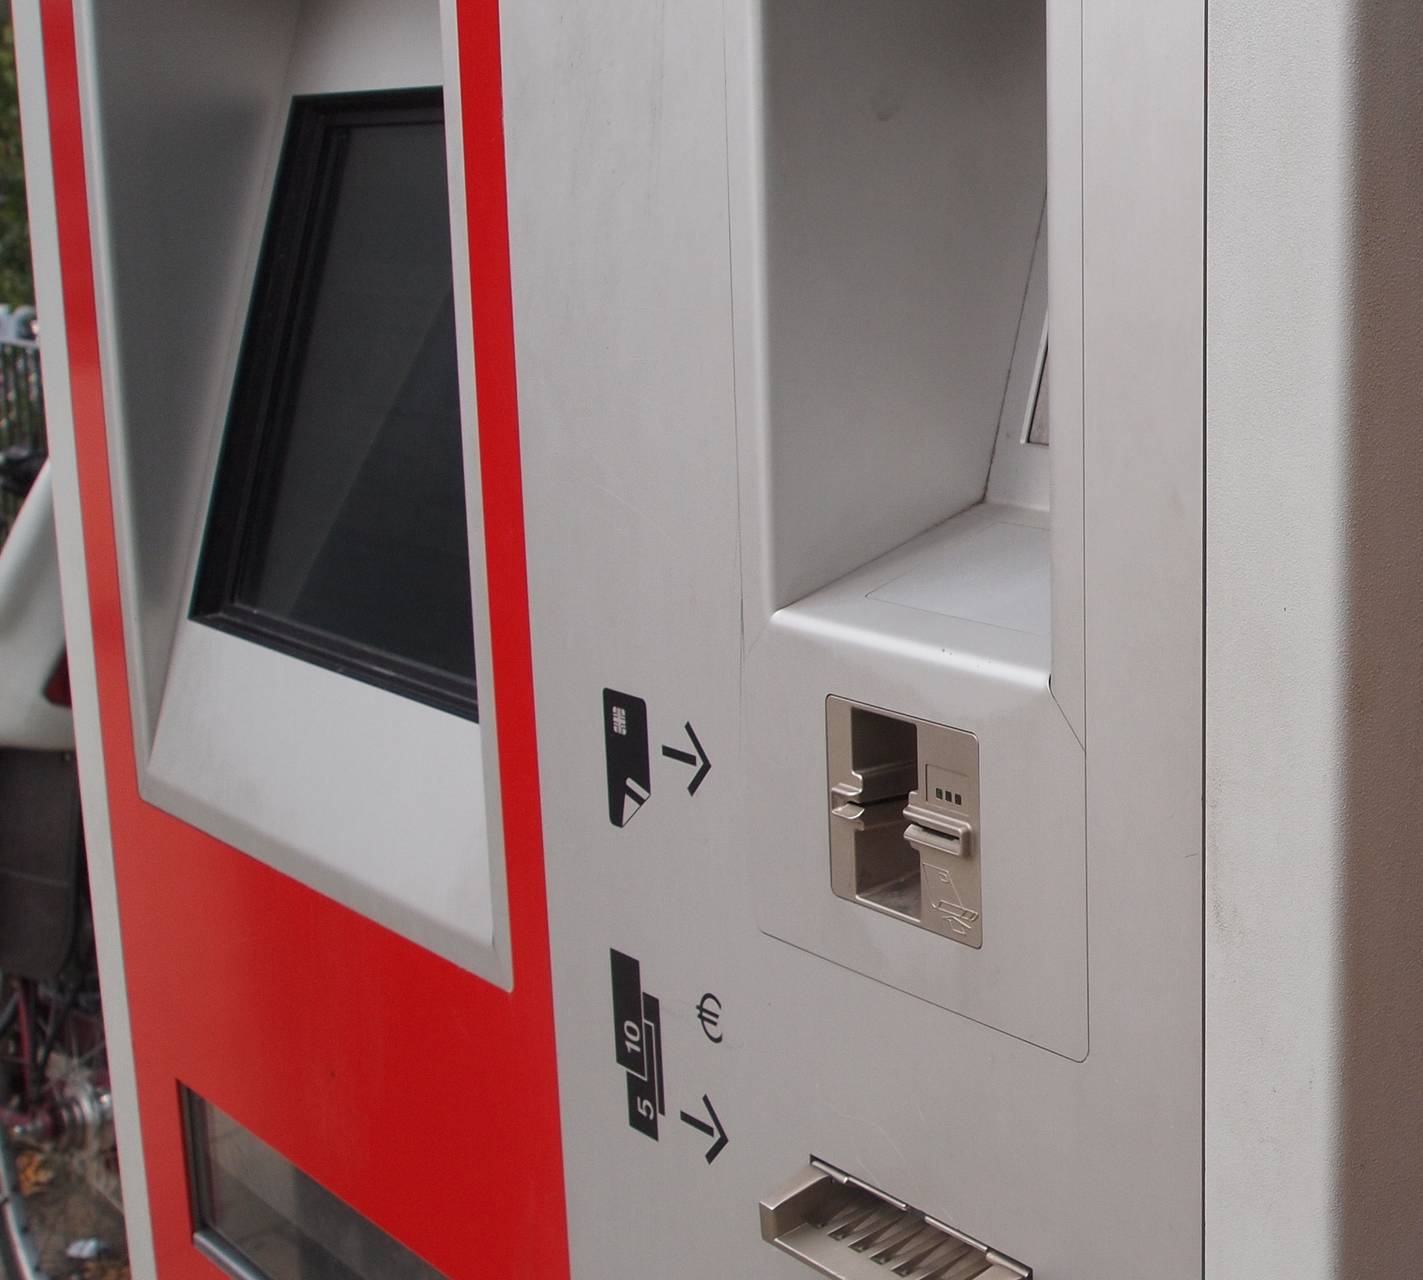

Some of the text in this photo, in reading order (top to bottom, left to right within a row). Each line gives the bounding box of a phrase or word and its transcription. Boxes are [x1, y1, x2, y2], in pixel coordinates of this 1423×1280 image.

[696, 993, 723, 1043] €
[623, 1020, 641, 1054] 10
[637, 1096, 655, 1120] 5
